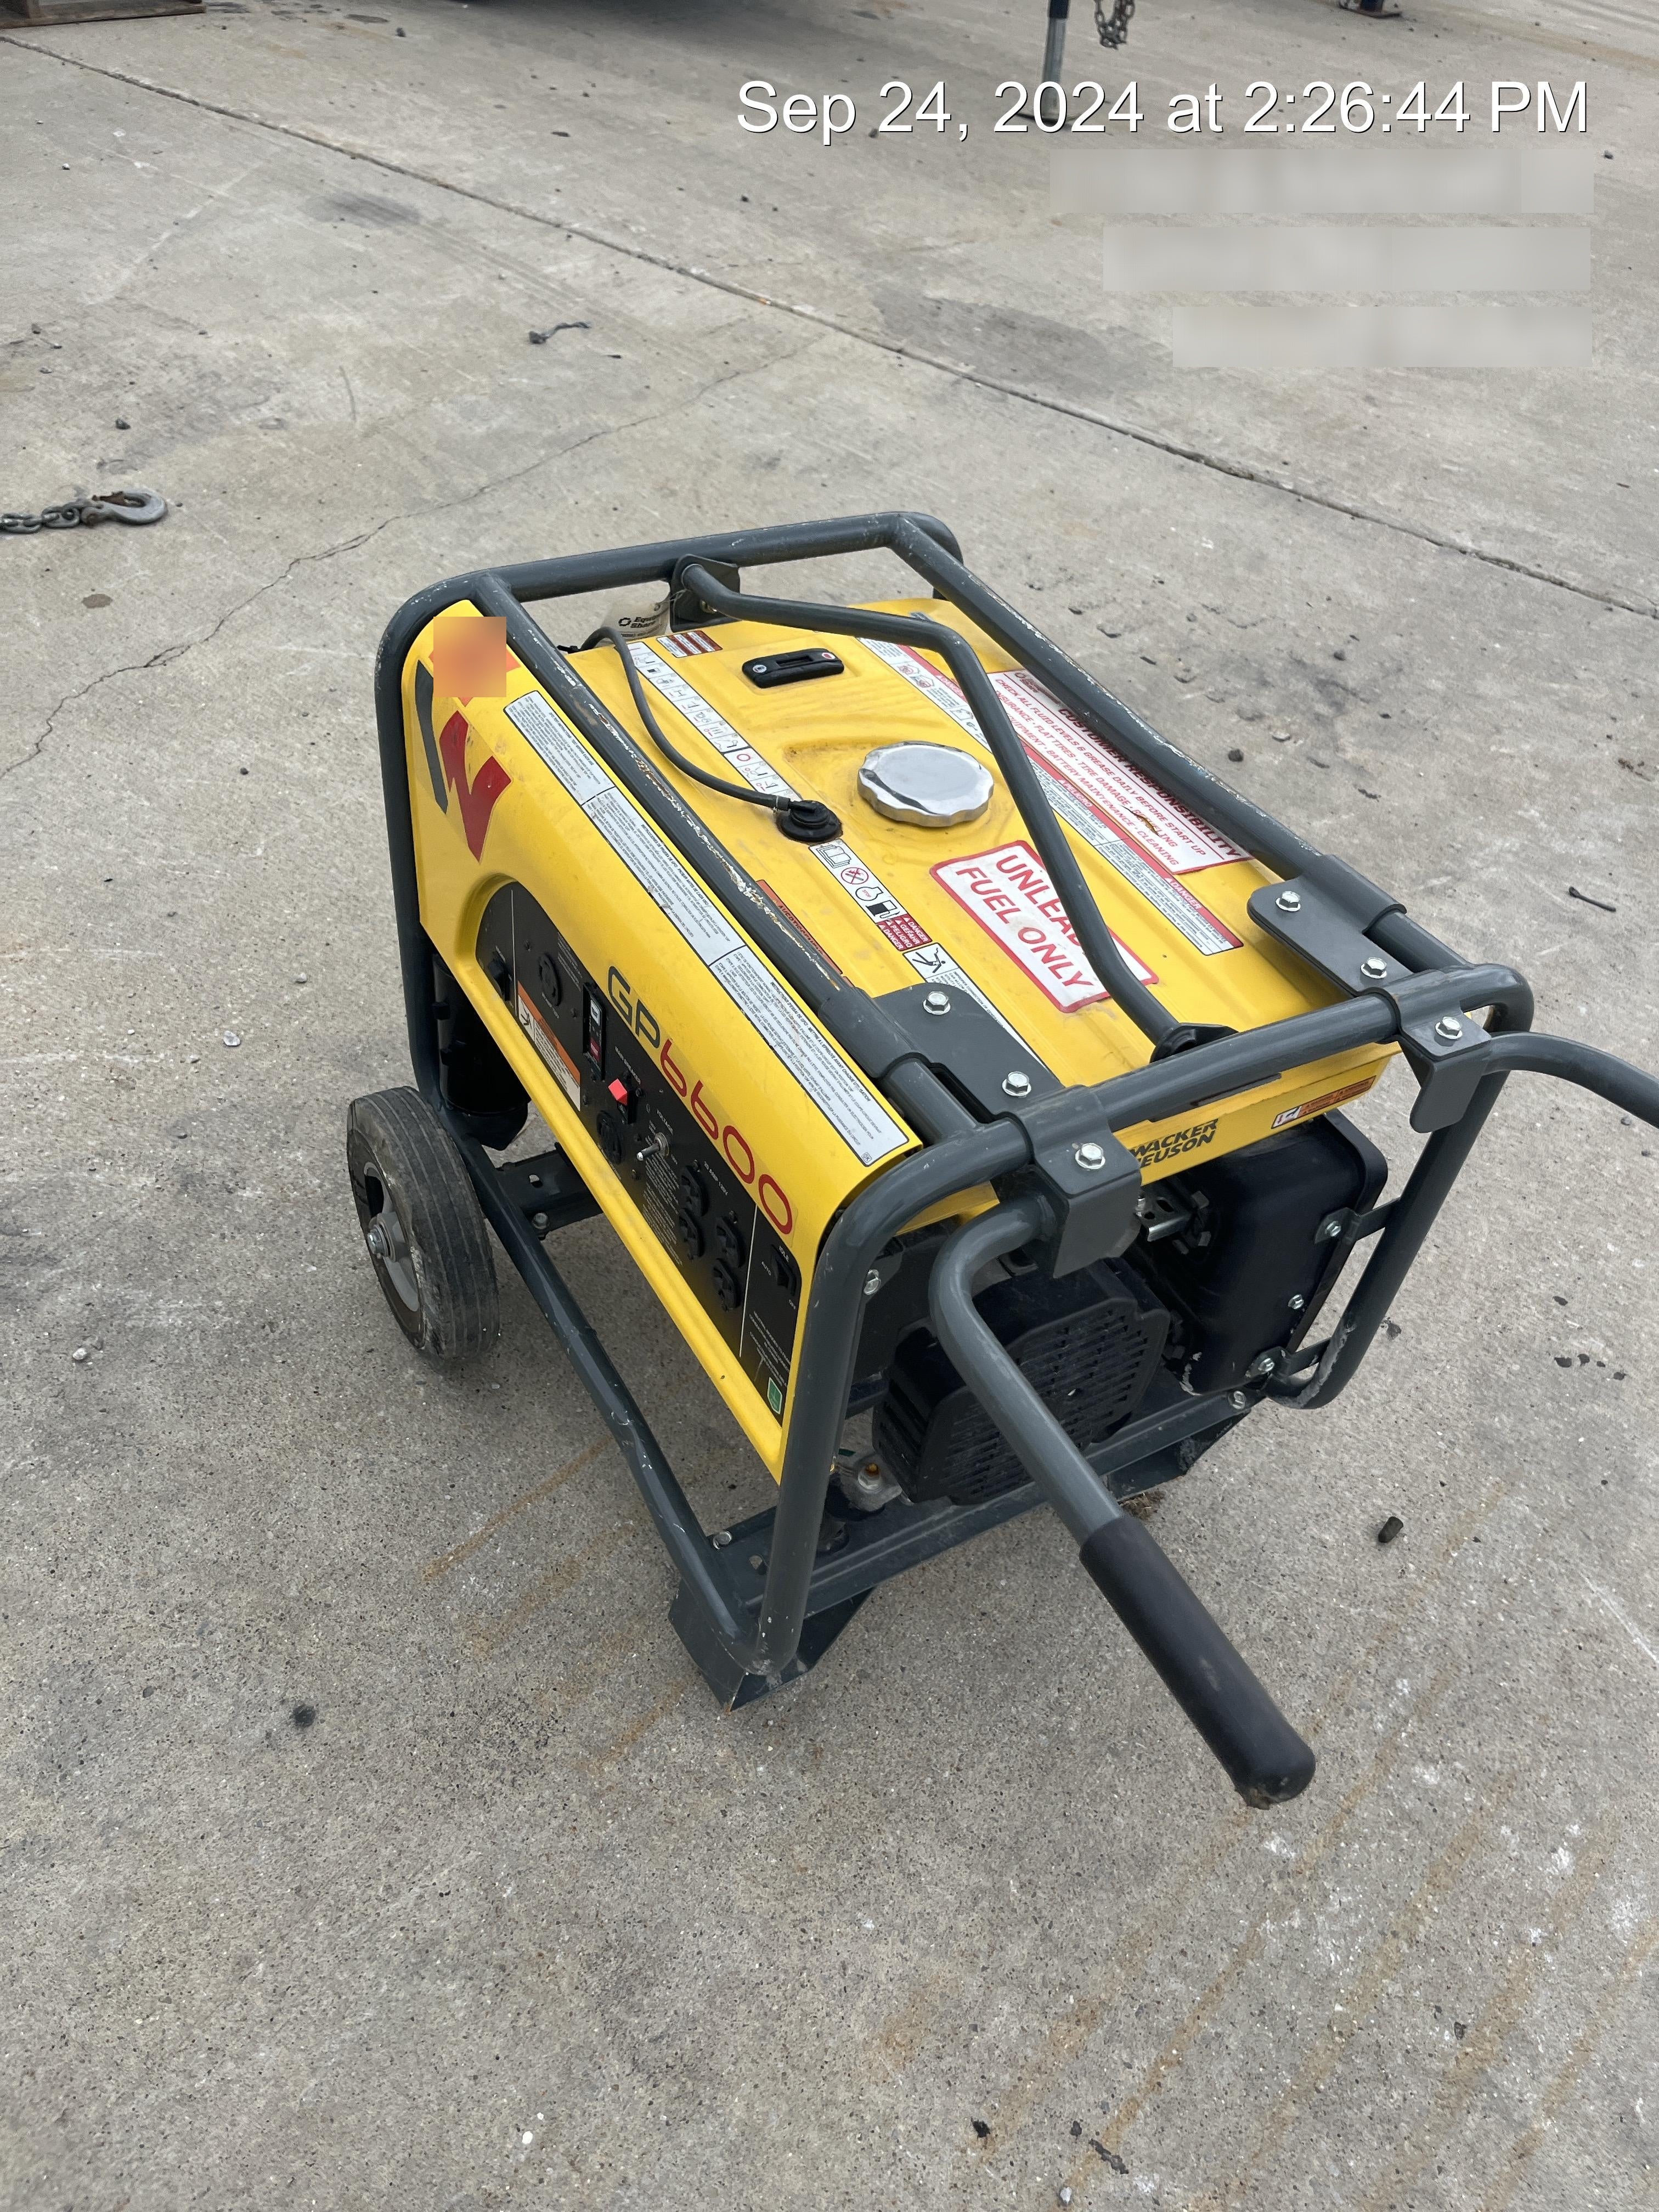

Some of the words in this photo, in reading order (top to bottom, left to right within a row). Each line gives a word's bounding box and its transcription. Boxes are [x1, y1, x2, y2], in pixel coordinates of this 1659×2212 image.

[995, 679, 1019, 696] CHECK
[1017, 697, 1032, 707] ALL
[1030, 707, 1054, 724] FLUID
[1051, 725, 1080, 746] LEVELS
[1084, 752, 1115, 776] GREASE
[1113, 777, 1138, 795] DAILY
[1136, 796, 1168, 822] BEFORE
[1165, 822, 1194, 843] START
[1191, 845, 1206, 855] UP
[1034, 725, 1054, 738] FLAT
[1052, 739, 1076, 758] TIRES
[1078, 761, 1098, 776] TIRE
[1095, 777, 1130, 805] DAMAGE
[1007, 713, 1046, 746] QUIPMENT
[1046, 747, 1081, 776] BATTERY
[1078, 776, 1136, 826] MAINTENANCE
[1137, 831, 1179, 865] CLEANING
[1170, 882, 1202, 909] DANGER
[883, 929, 904, 950] DANGER
[890, 924, 913, 948] PELIGRO
[907, 921, 928, 943] DANGER
[955, 867, 1021, 924] FUEL
[1017, 927, 1094, 987] ONLY
[608, 966, 793, 1234] GP6600
[1128, 1118, 1219, 1156] WACKER
[1138, 1130, 1215, 1168] EUSON
